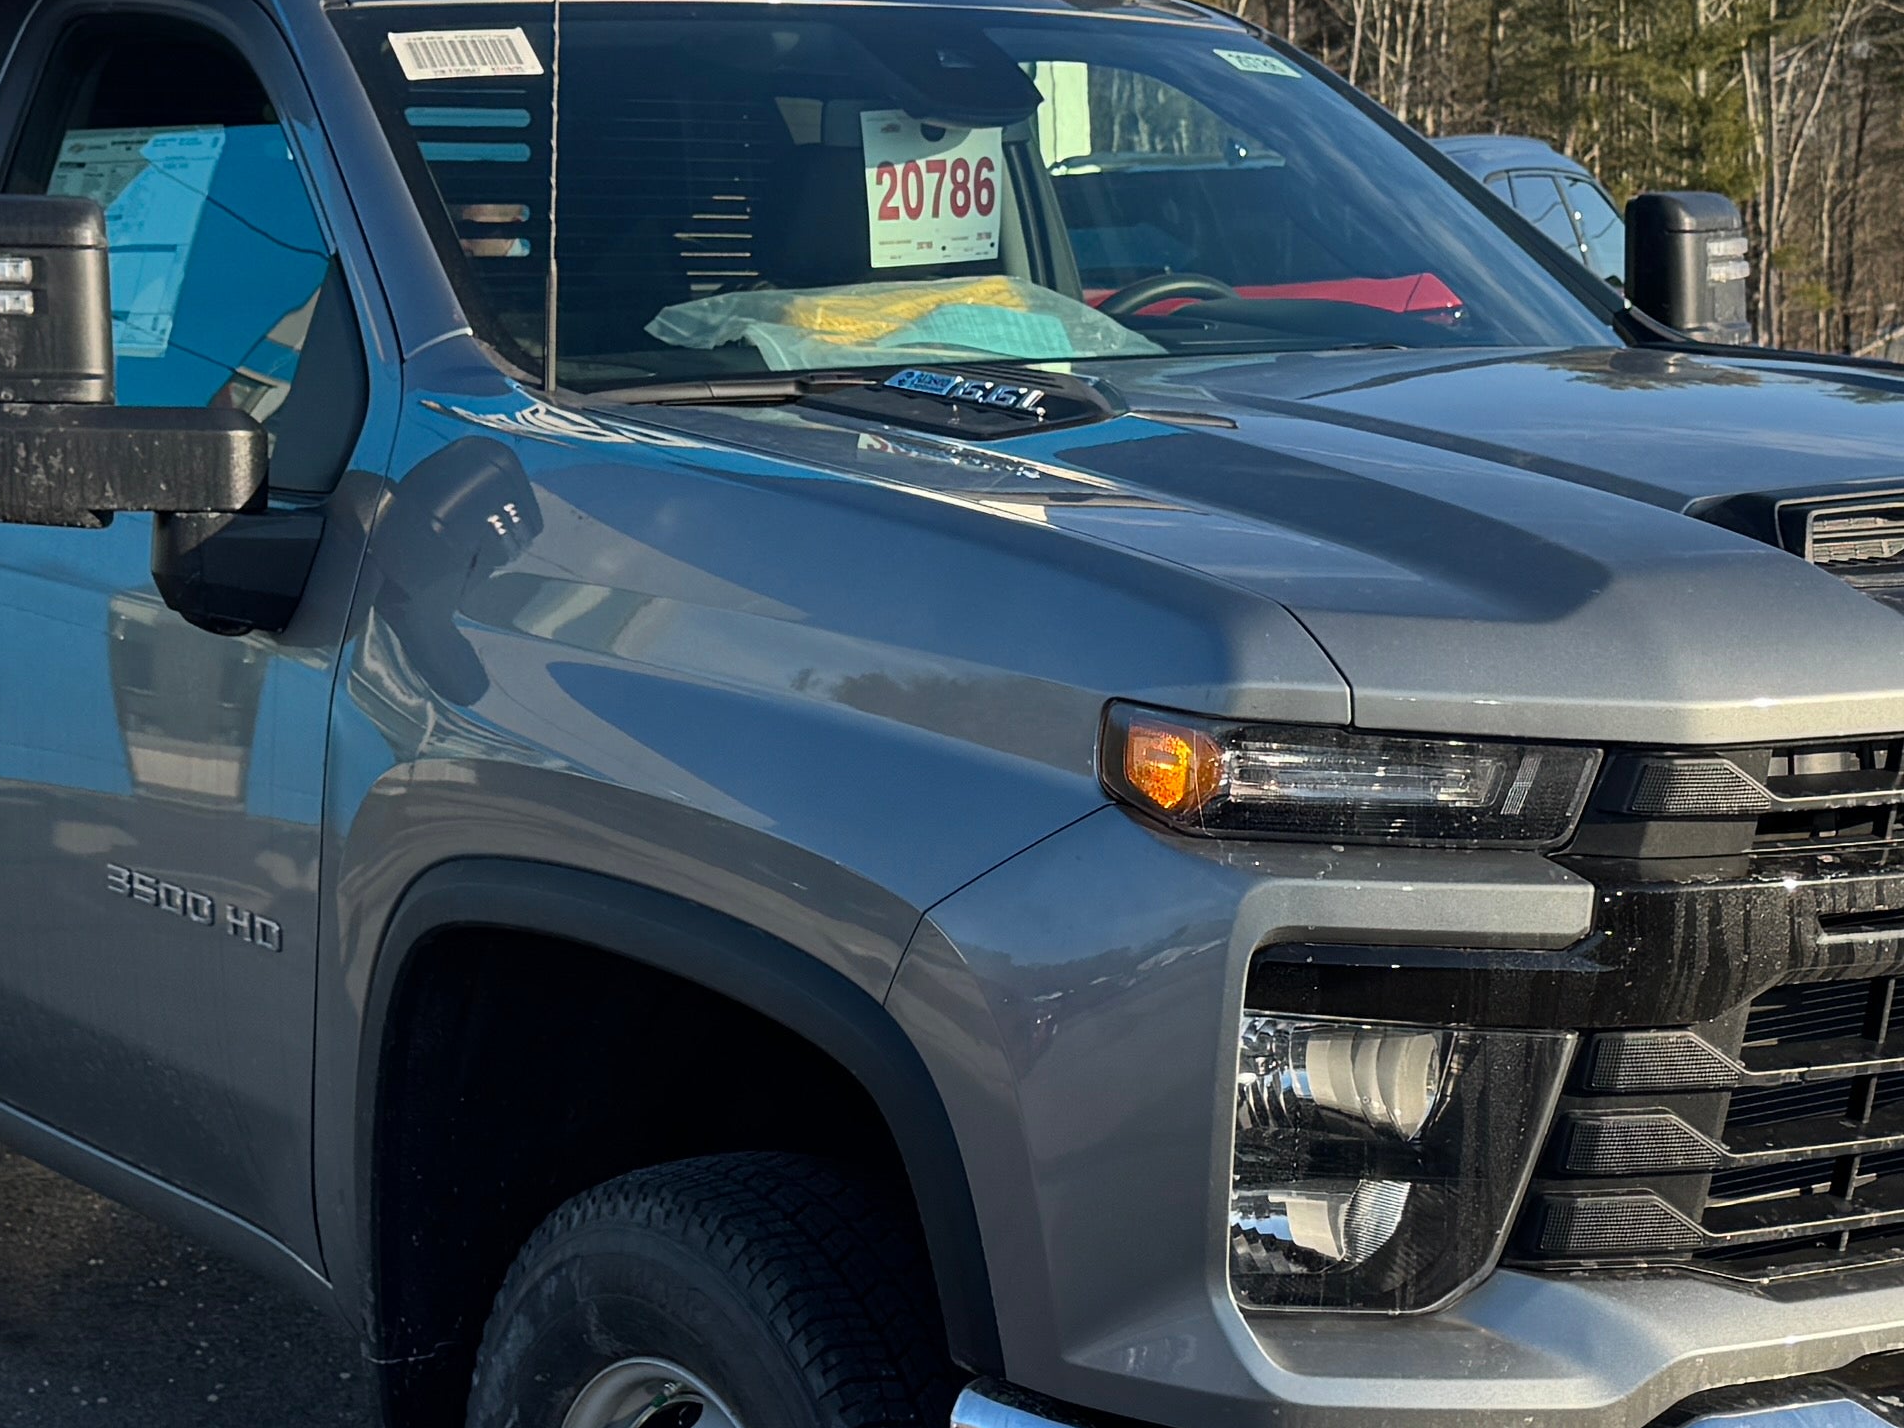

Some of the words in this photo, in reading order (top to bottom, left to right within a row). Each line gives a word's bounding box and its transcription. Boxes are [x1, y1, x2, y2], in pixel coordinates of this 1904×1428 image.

[876, 156, 995, 221] 20786
[107, 863, 214, 926] 3500
[226, 904, 282, 953] HD
